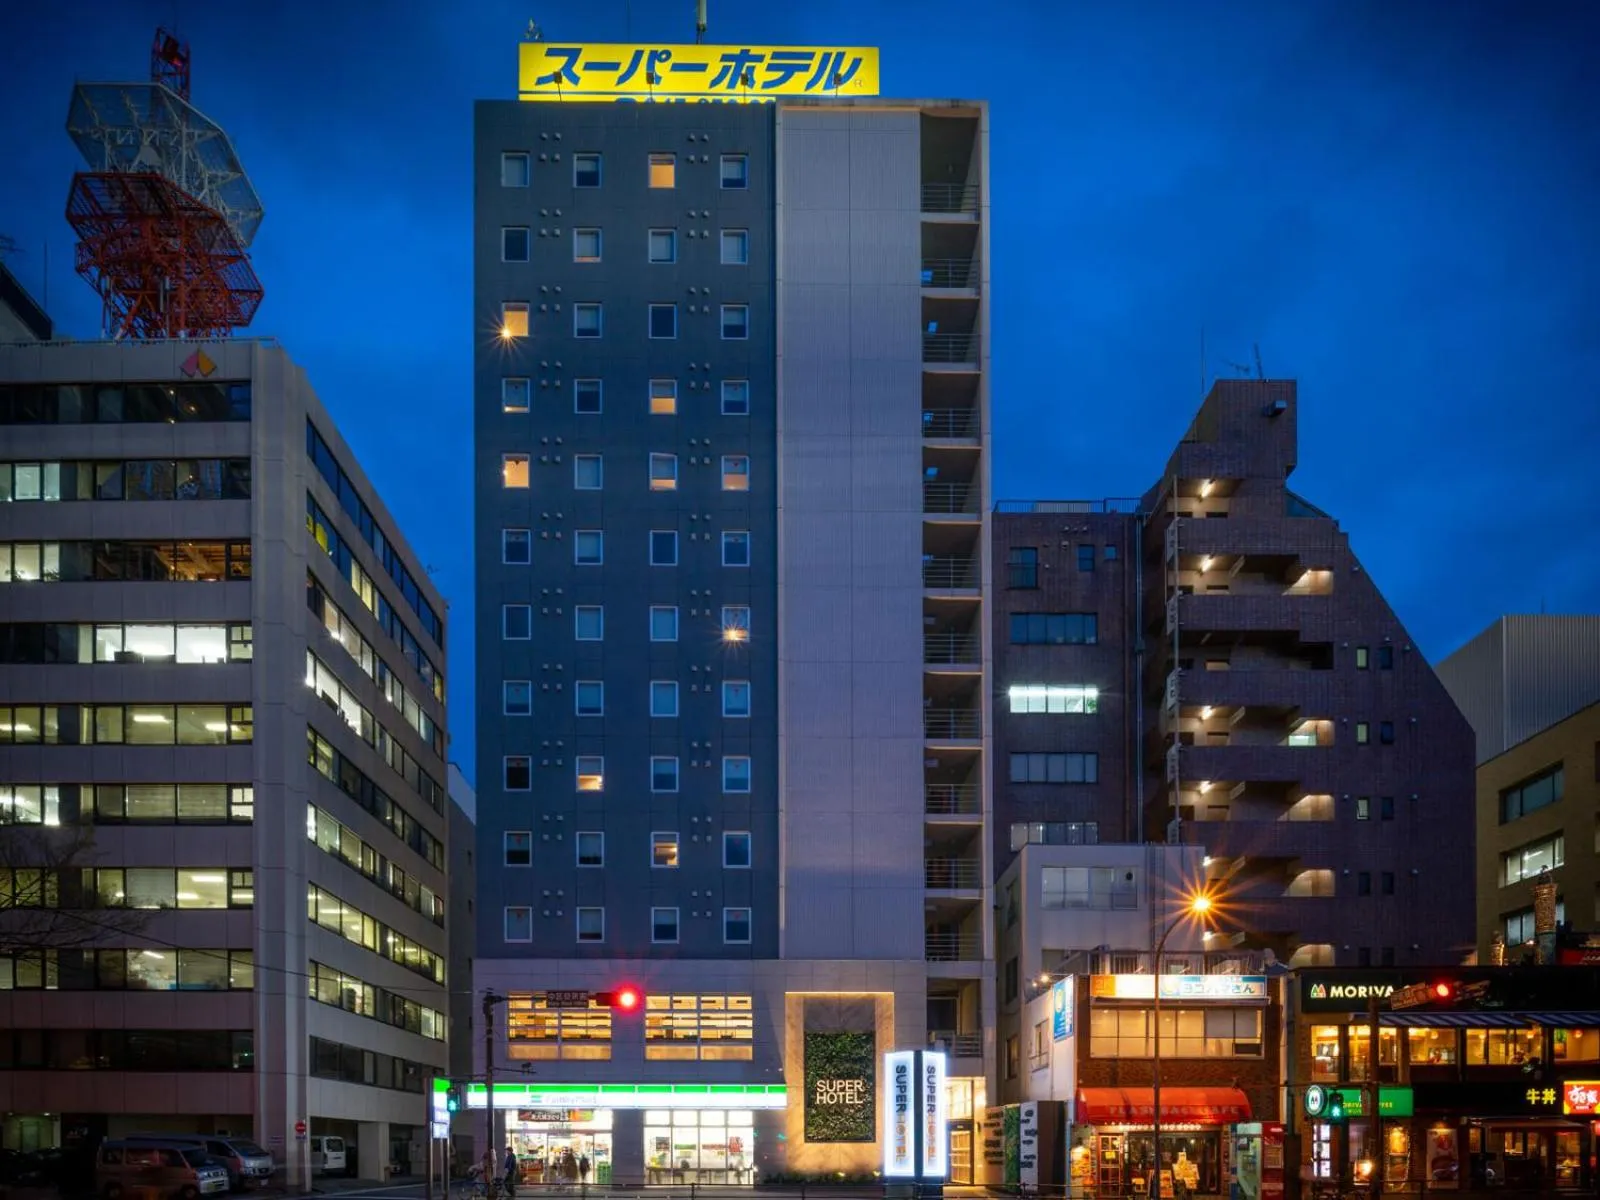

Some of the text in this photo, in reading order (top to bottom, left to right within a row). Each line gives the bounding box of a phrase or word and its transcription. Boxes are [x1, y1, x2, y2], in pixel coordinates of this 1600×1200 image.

[535, 47, 864, 92] スーパーホテル
[816, 1079, 865, 1092] SUPER
[816, 1091, 864, 1104] HOTEL
[895, 1064, 907, 1113] SUPER
[926, 1064, 937, 1113] SUPER
[1526, 1088, 1556, 1105] 牛丼
